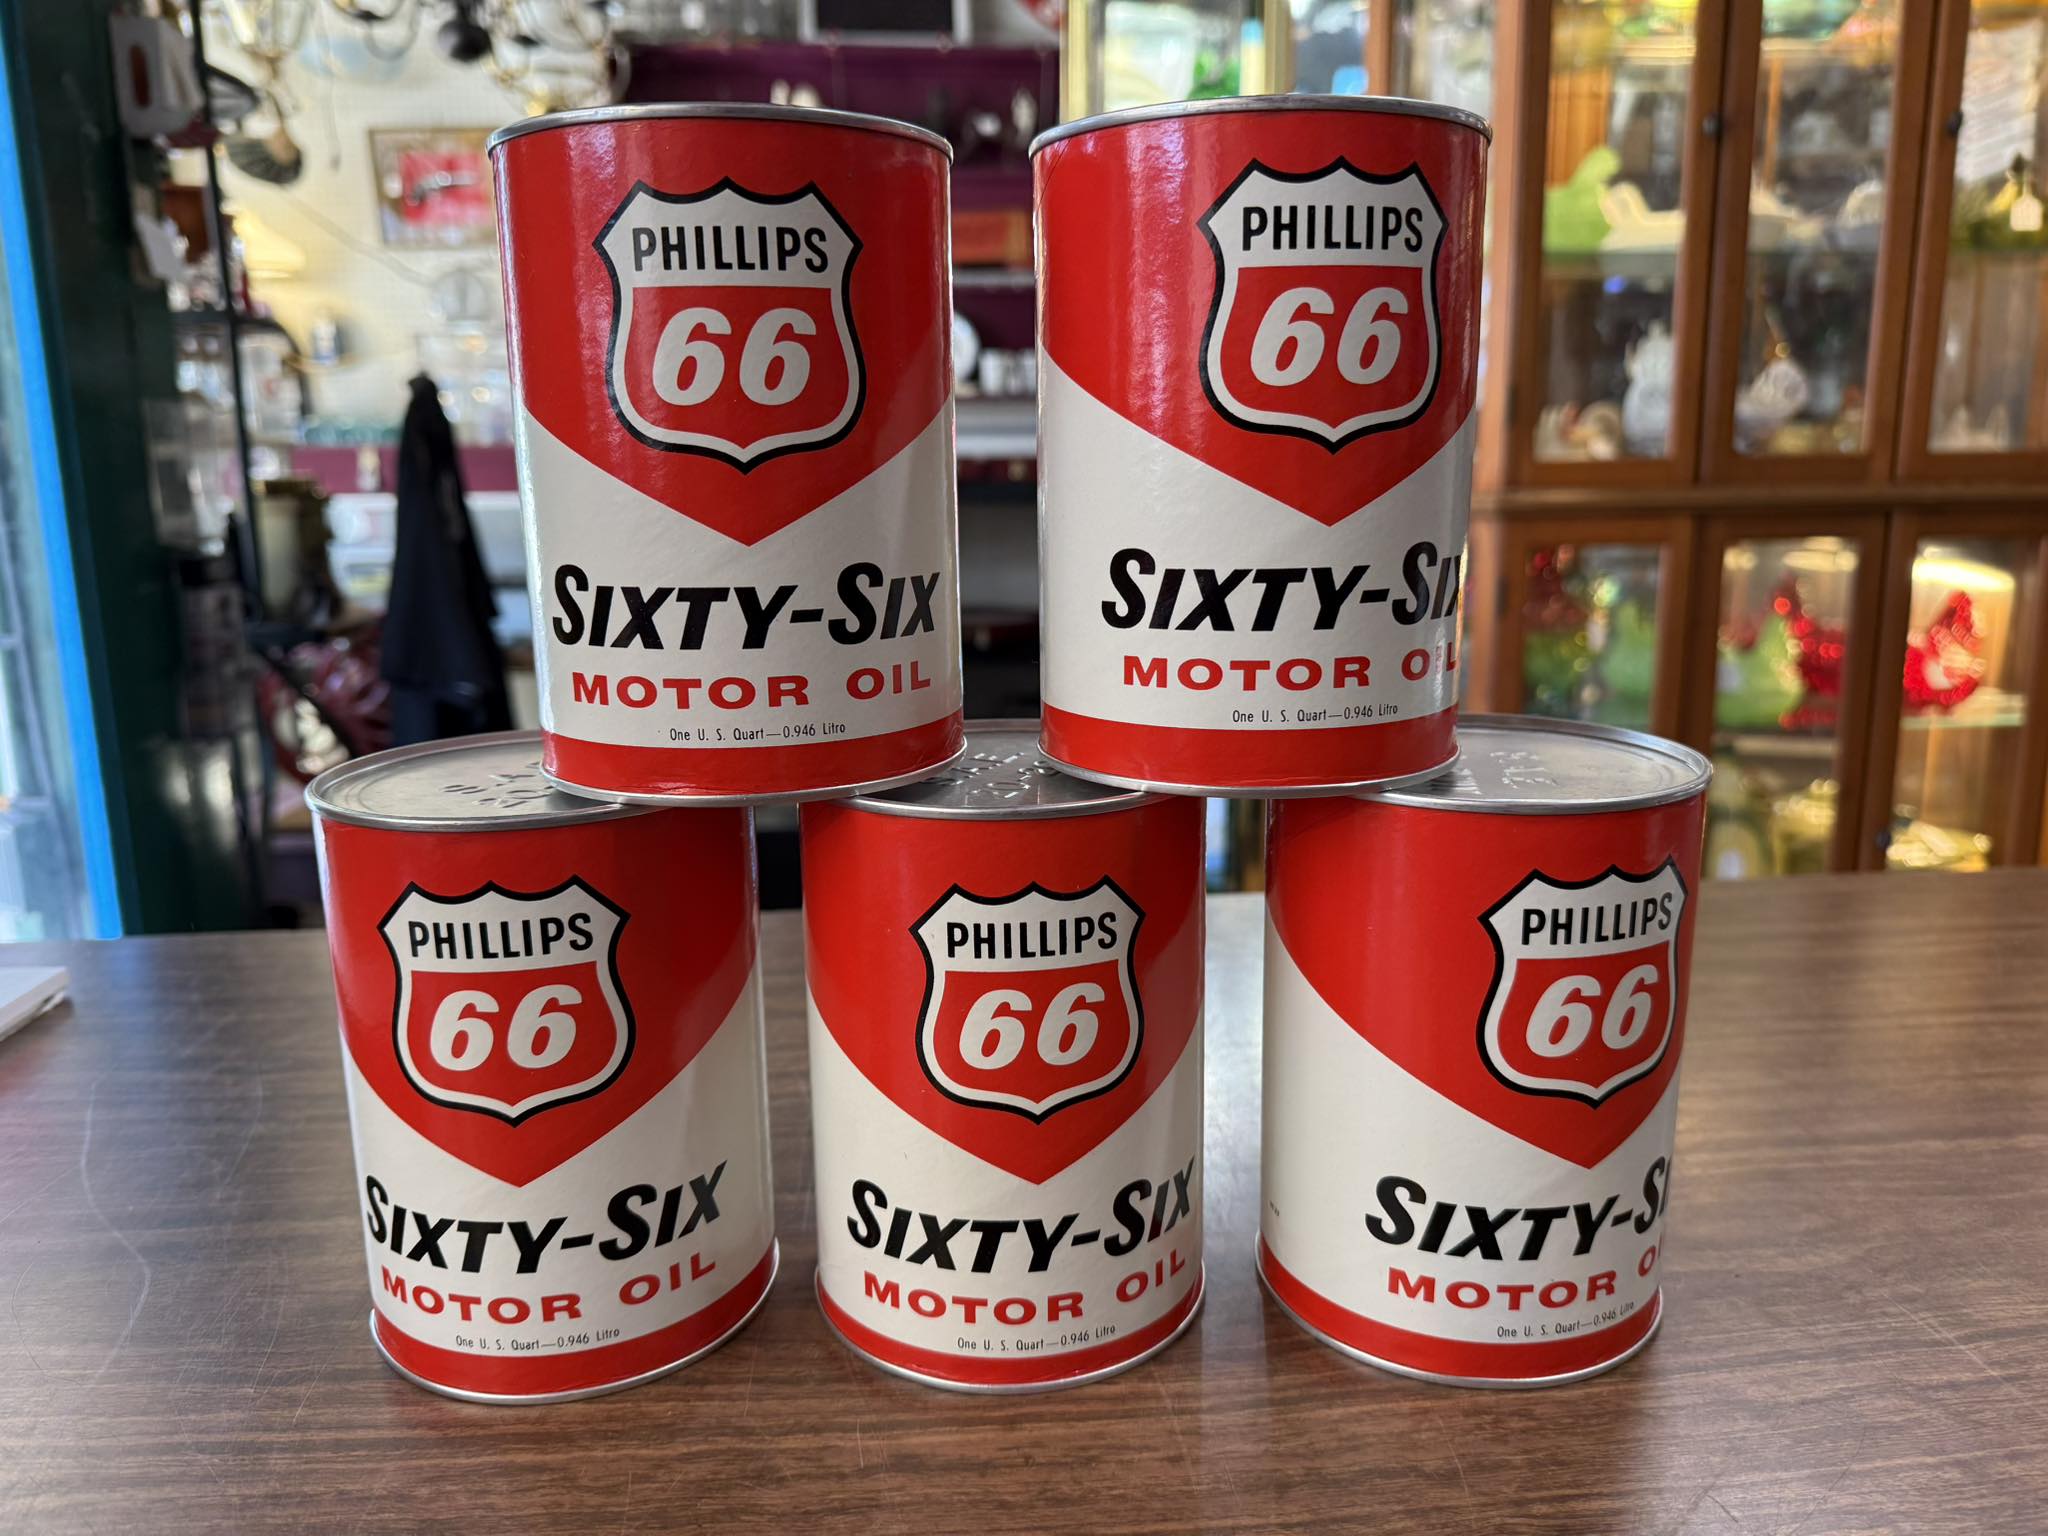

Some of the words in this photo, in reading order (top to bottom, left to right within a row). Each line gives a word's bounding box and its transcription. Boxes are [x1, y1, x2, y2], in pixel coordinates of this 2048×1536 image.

[632, 226, 828, 273] PHILLIPS
[1242, 204, 1423, 253] PHILLIPS
[652, 307, 816, 406] 66
[1250, 286, 1408, 387] 66
[552, 561, 940, 650] SIXTY-SIX
[572, 671, 809, 710] MOTOR
[846, 660, 931, 701] OIL
[1123, 655, 1371, 691] MOTOR
[669, 727, 691, 742] One
[823, 722, 846, 736] Litro
[1232, 709, 1254, 723] One
[1378, 704, 1398, 718] Litro
[408, 912, 594, 960] PHILLIPS
[947, 911, 1118, 960] PHILLIPS
[1521, 892, 1673, 946] PHILLIPS
[430, 984, 582, 1071] 66
[958, 982, 1105, 1070] 66
[1526, 963, 1659, 1059] 66
[366, 1160, 728, 1274] SIXTY-SIX
[847, 1157, 1194, 1274] SIXTY-SIX
[381, 1265, 582, 1324] MOTOR
[619, 1252, 716, 1305] OIL
[864, 1270, 1084, 1325] MOTOR
[1116, 1249, 1186, 1303] OIL
[1387, 1266, 1617, 1311] MOTOR
[456, 1334, 474, 1349] One
[596, 1326, 620, 1342] Litro
[957, 1336, 977, 1350] One
[1095, 1324, 1116, 1340] Litro
[1497, 1326, 1517, 1338] One
